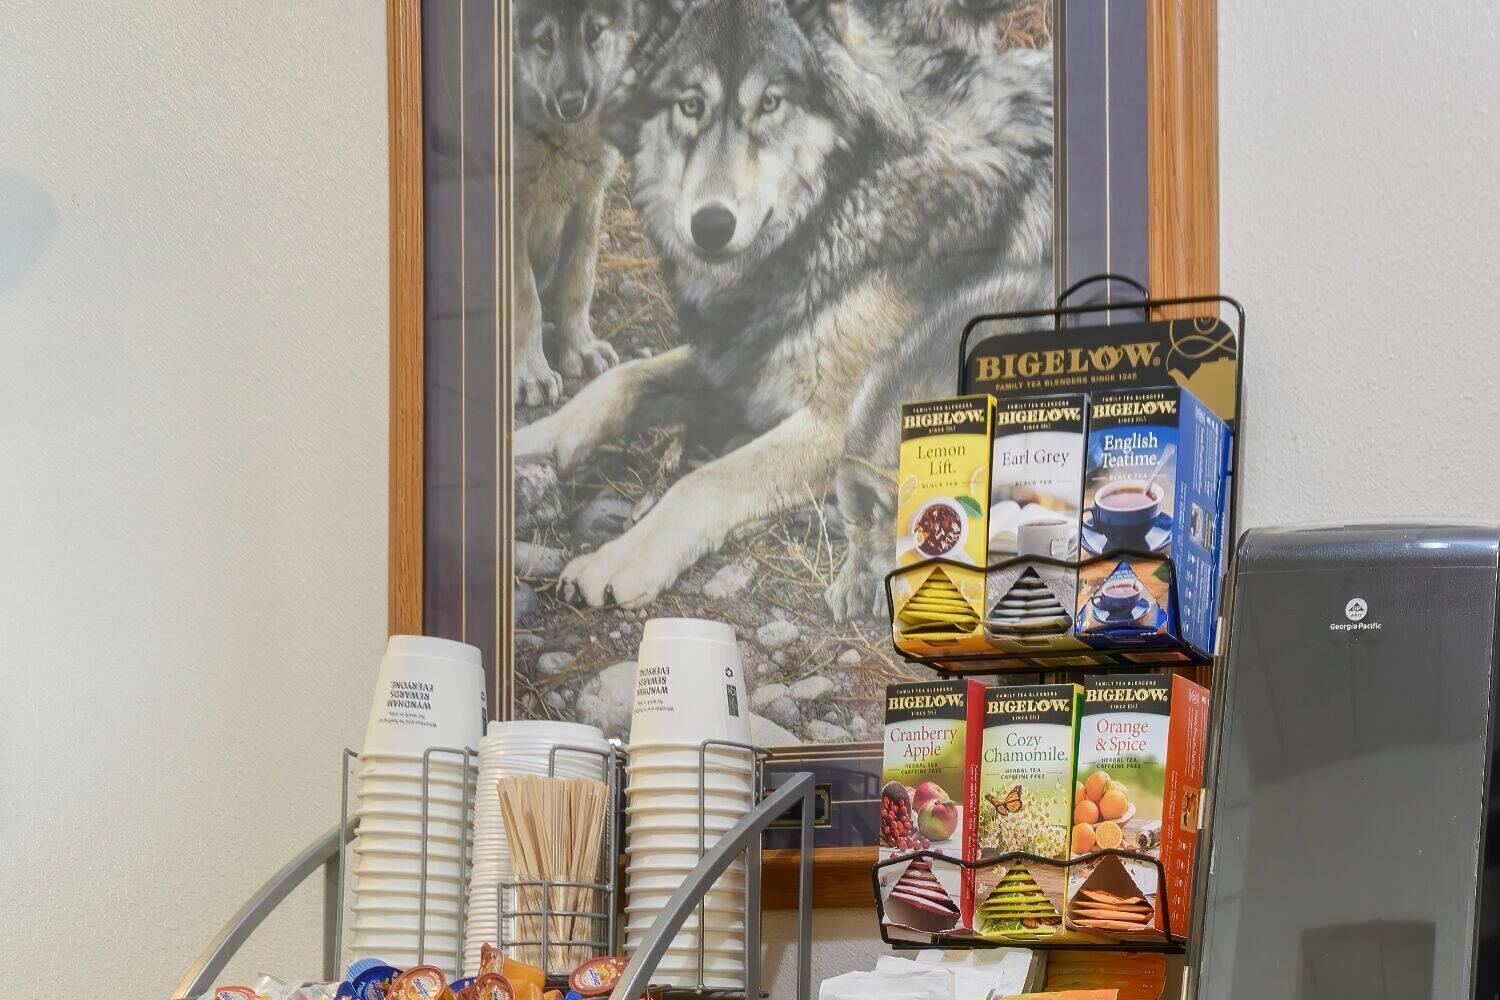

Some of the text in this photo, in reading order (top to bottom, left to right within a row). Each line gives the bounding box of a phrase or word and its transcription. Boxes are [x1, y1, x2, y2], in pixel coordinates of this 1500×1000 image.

[976, 342, 1160, 382] BIGELOW
[996, 382, 1022, 391] FAMILY
[1026, 381, 1041, 389] TEA
[1044, 377, 1087, 387] BLENDERS
[998, 408, 1080, 426] BIGELOW
[1092, 400, 1176, 419] BIGELOW
[904, 409, 984, 430] BIGELOW
[1104, 432, 1158, 453] English
[918, 445, 966, 459] Lemon
[1002, 448, 1069, 467] Earl Grey
[390, 690, 430, 700] REWARDS
[888, 694, 964, 710] BIGELOW
[1085, 688, 1169, 703] BIGELOW
[387, 699, 431, 710] WYNDHAM
[986, 699, 1070, 715] BIGELOW
[890, 726, 957, 748] Cranberry
[1097, 718, 1149, 738] Orange
[1006, 732, 1042, 749] Cozy
[1095, 736, 1147, 755] & Spice
[903, 742, 941, 761] Apple
